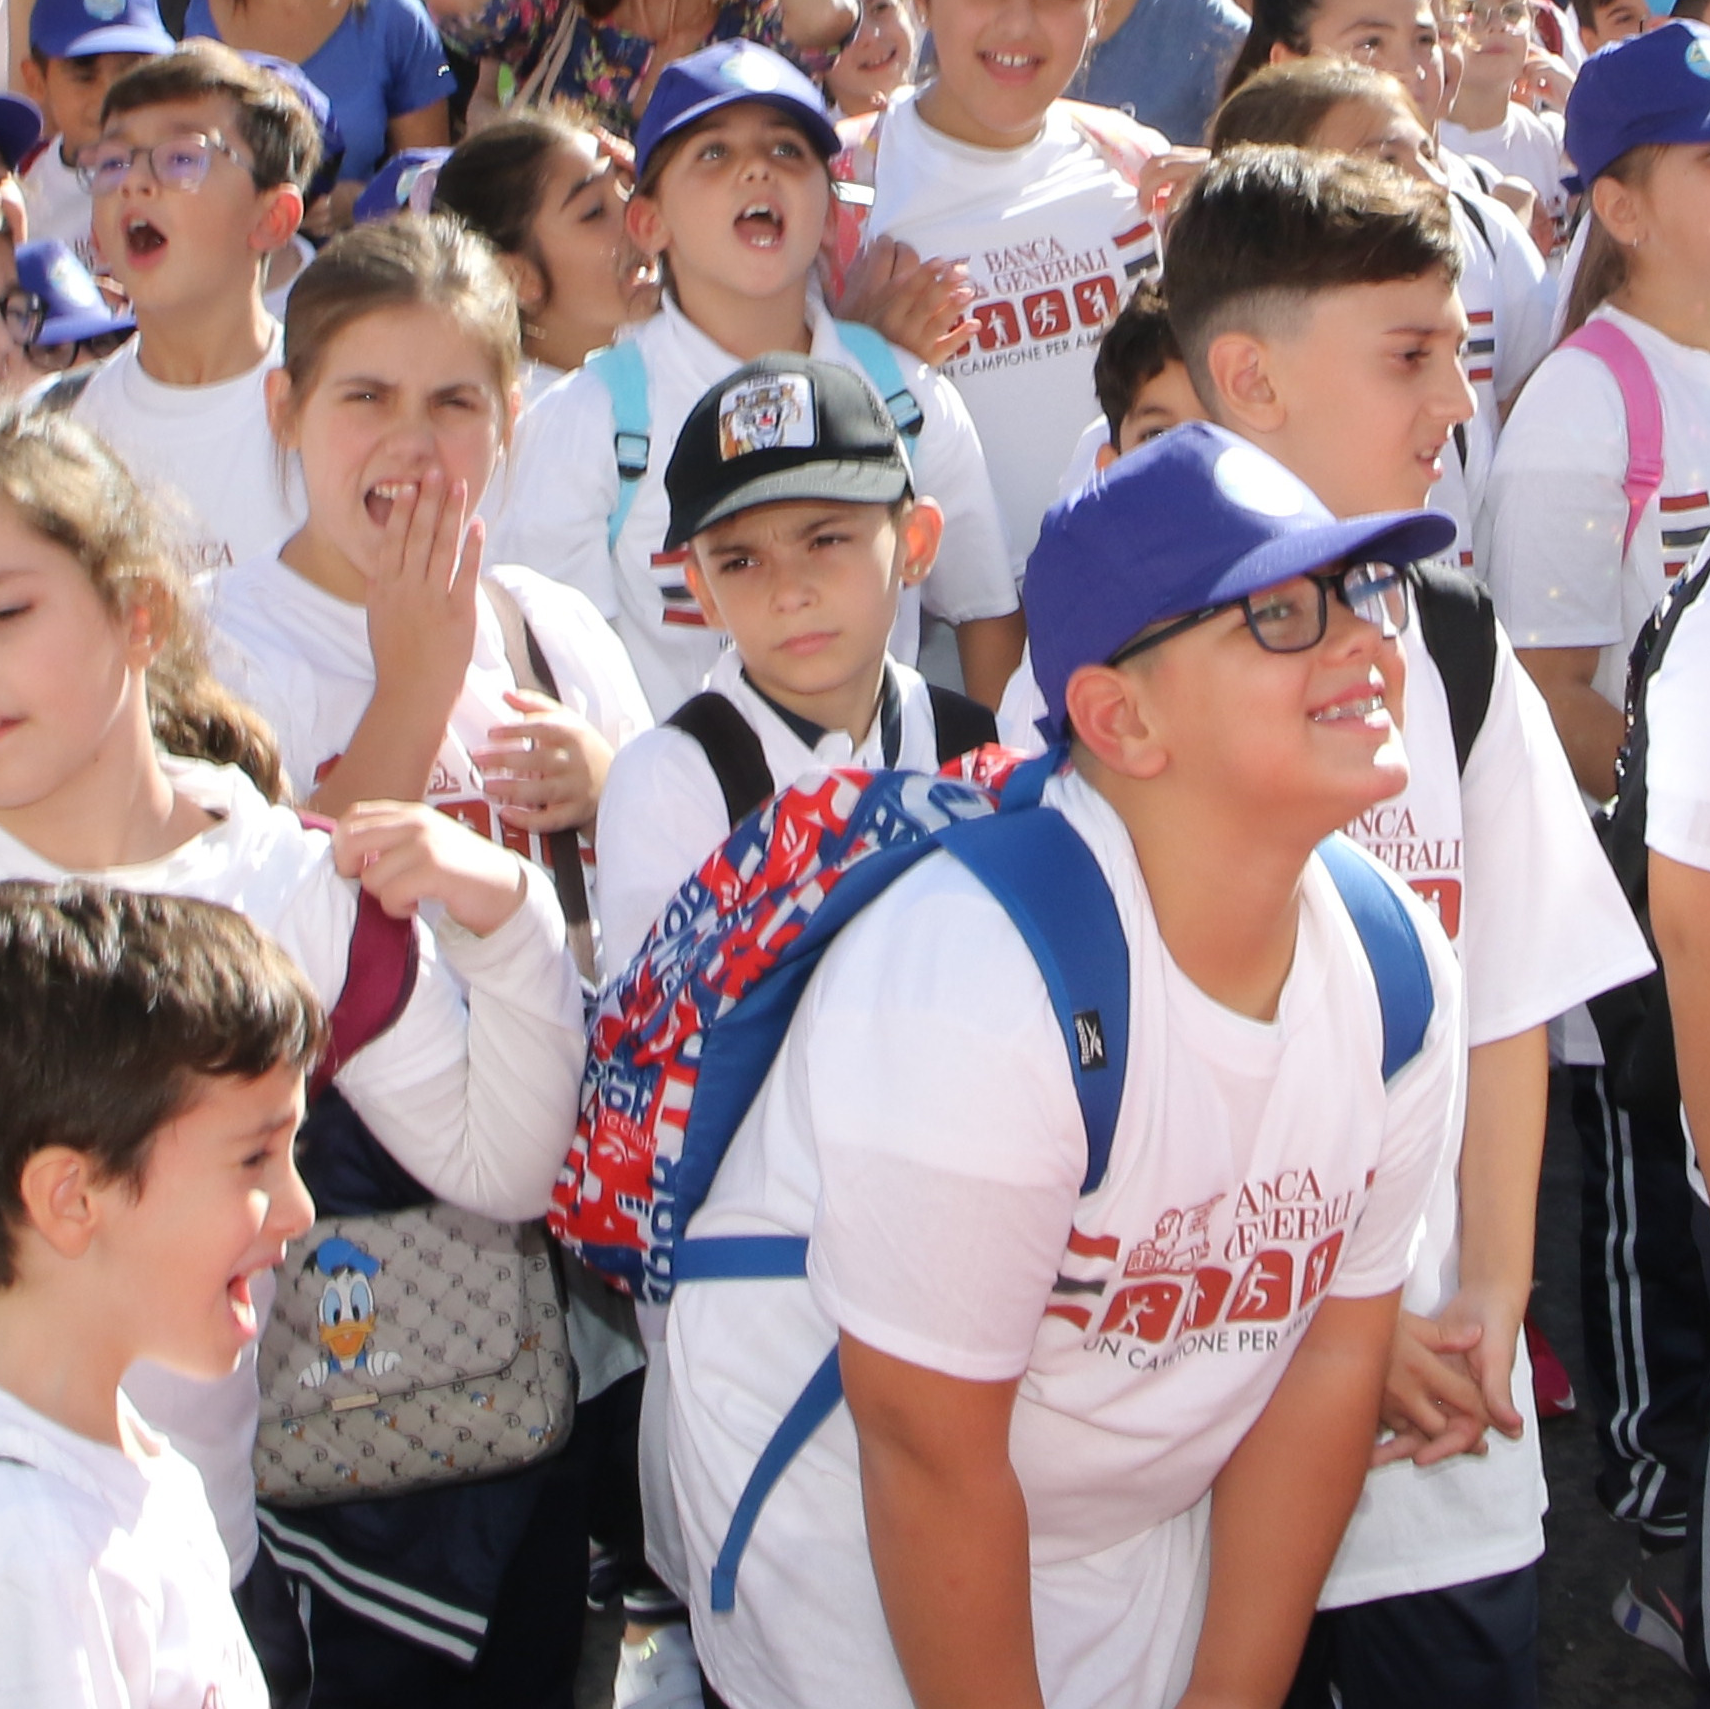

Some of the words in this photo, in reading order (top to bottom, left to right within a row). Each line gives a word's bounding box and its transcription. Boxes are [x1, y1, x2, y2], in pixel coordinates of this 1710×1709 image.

[984, 234, 1065, 274] BANCA
[993, 247, 1109, 295] GENERALI
[960, 345, 1041, 377] CAMPIONE
[1046, 338, 1069, 358] PER
[1235, 1167, 1322, 1218] ANCA
[1083, 1335, 1122, 1359] UN
[1238, 1329, 1279, 1352] PER
